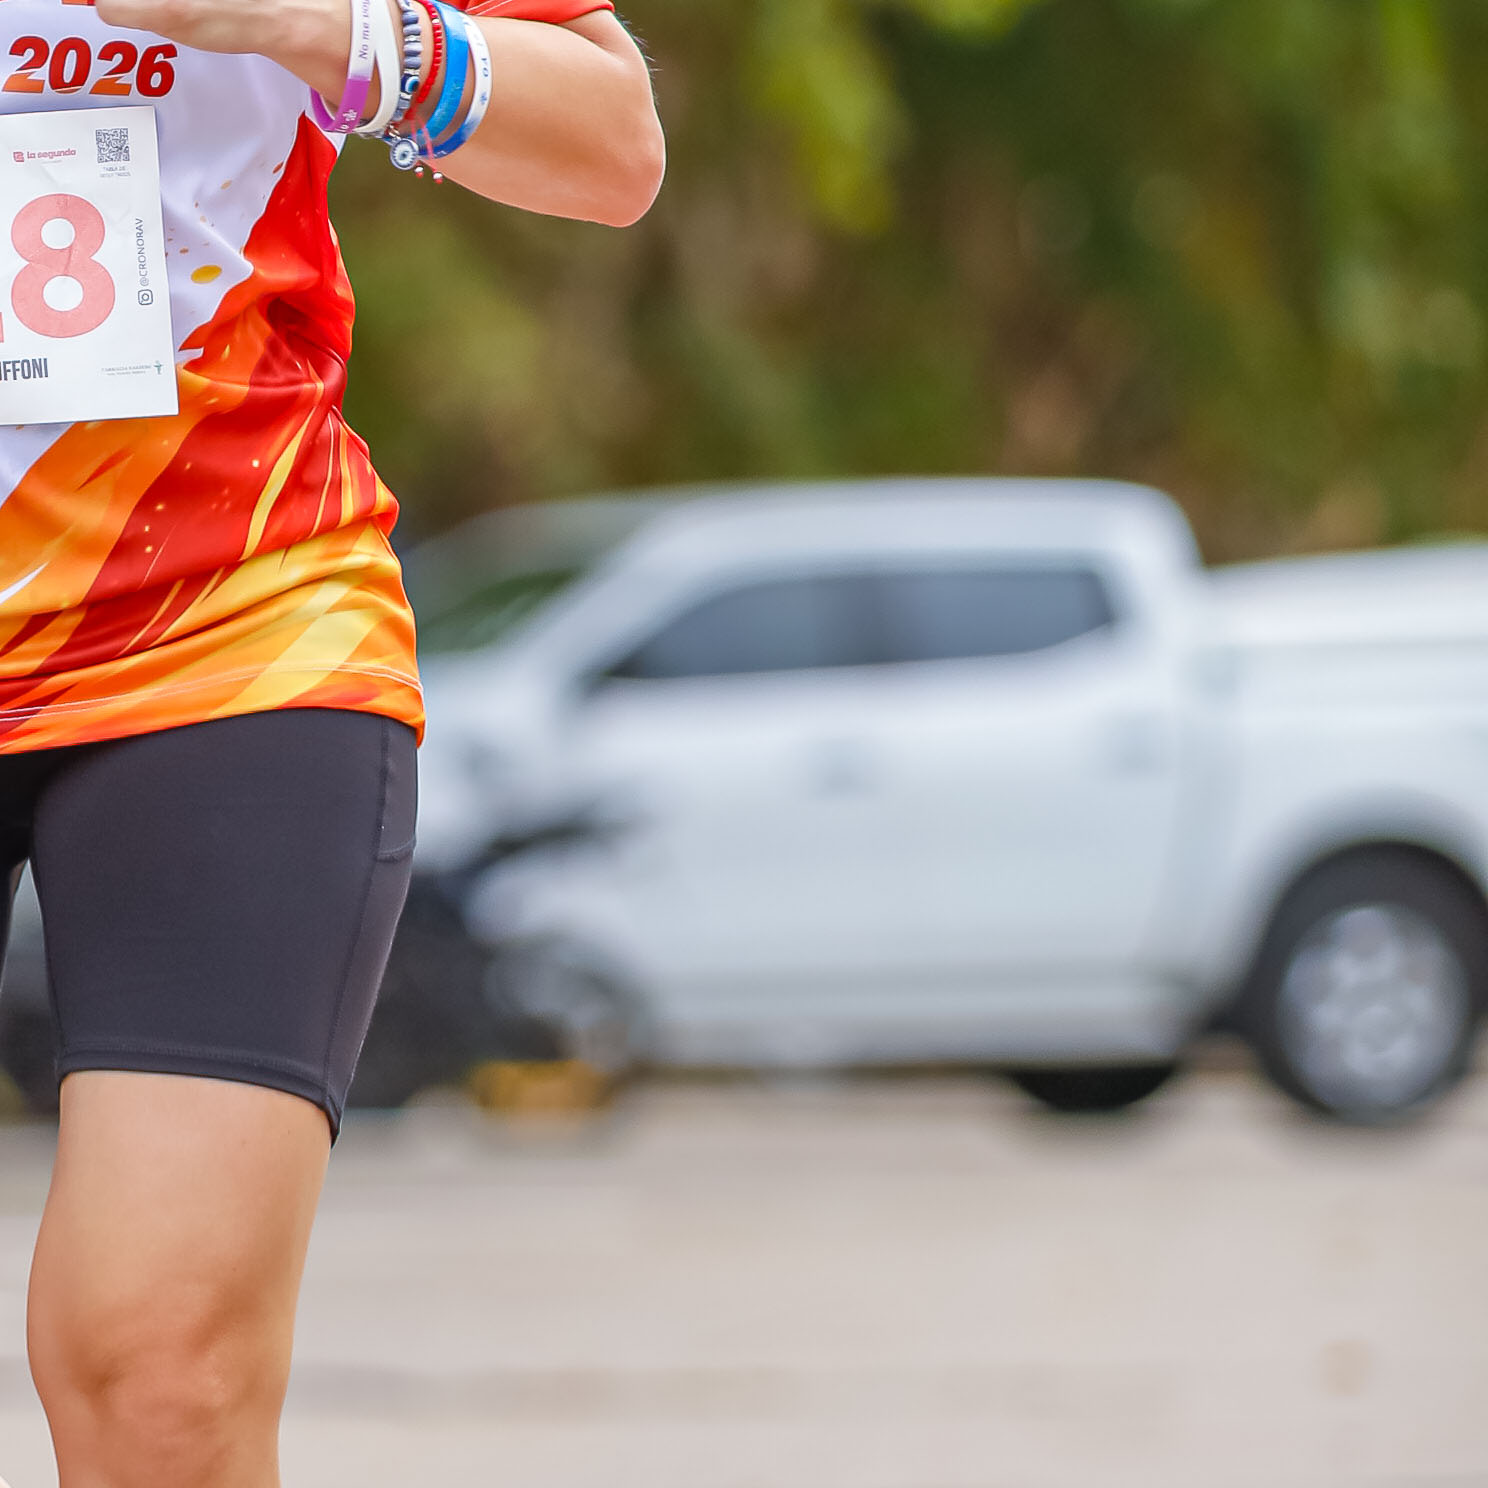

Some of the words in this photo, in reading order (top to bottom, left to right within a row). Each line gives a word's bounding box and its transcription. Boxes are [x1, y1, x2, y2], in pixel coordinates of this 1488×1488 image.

[362, 22, 370, 40] me
[358, 44, 368, 60] No
[2, 35, 178, 98] 2026
[37, 148, 76, 159] segunda
[135, 218, 149, 287] @CRONORAV
